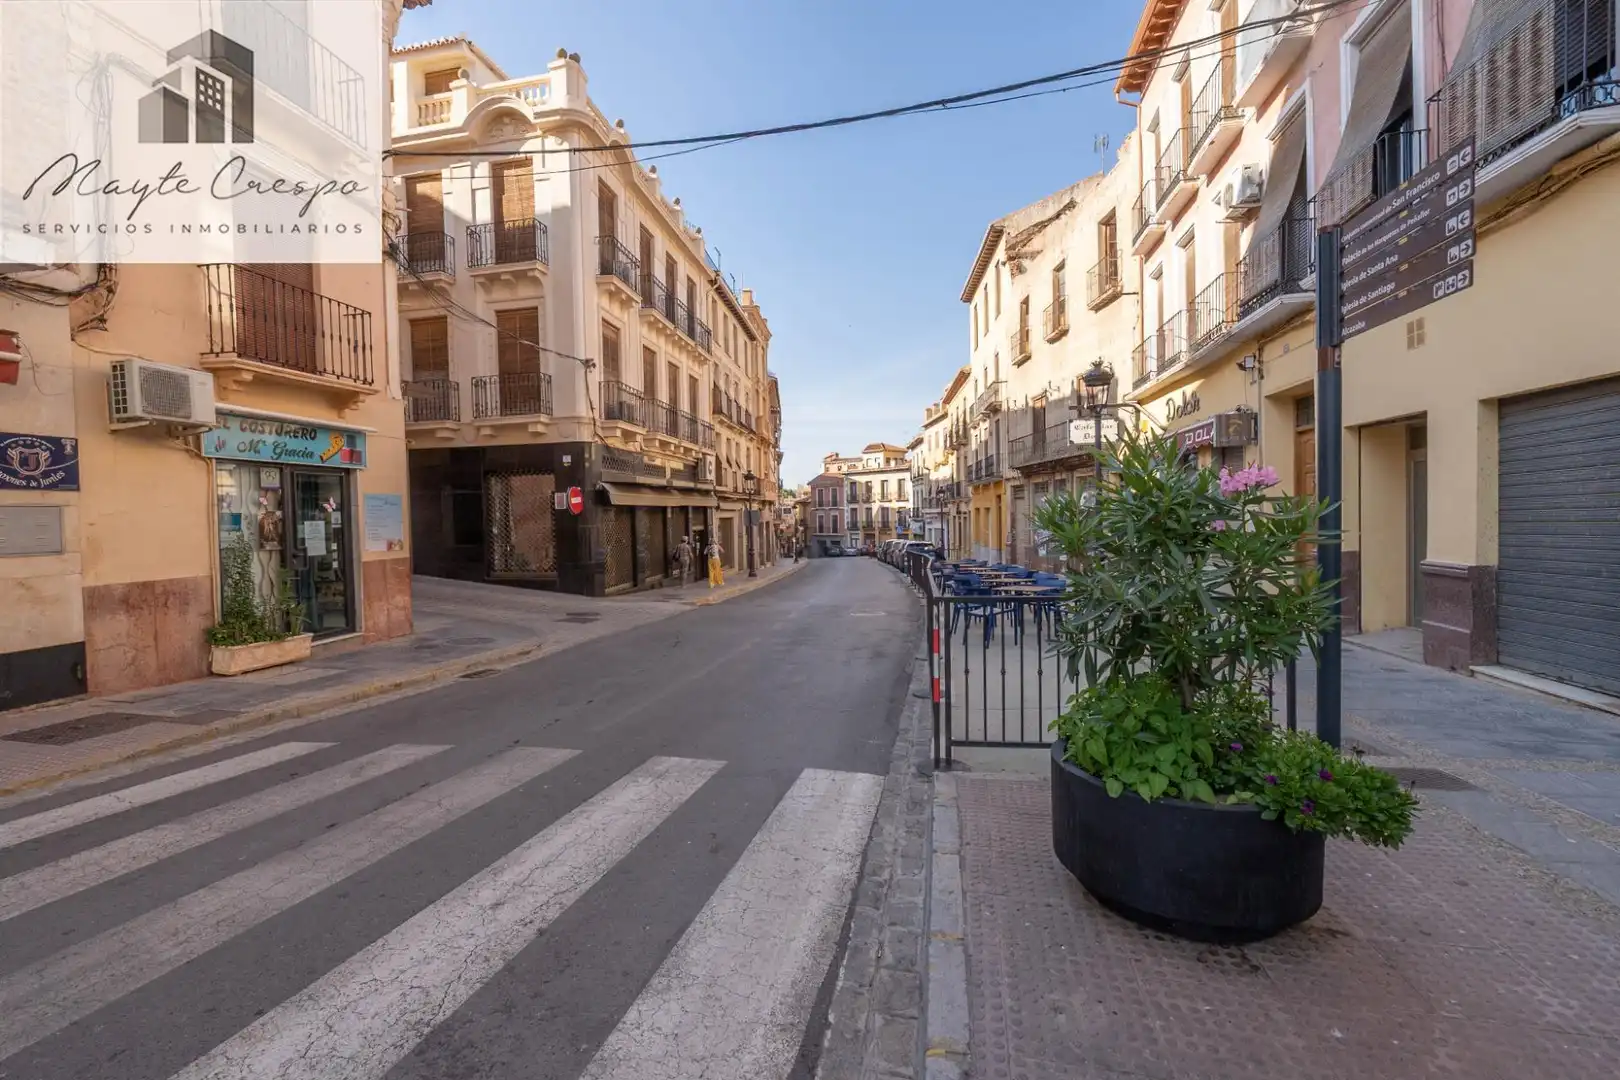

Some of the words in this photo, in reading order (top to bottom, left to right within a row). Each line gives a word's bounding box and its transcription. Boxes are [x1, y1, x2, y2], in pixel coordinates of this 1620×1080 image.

[1392, 196, 1405, 209] San
[1405, 172, 1440, 200] Francisco
[1341, 249, 1361, 267] Palacio
[1400, 223, 1406, 231] de
[1341, 275, 1358, 292] Iglesia
[1359, 271, 1367, 281] de
[1367, 261, 1385, 277] Santa
[1385, 254, 1398, 267] Ana
[1341, 299, 1358, 315] Iglesia
[1360, 295, 1367, 304] de
[1367, 282, 1396, 301] Santiago
[1341, 320, 1366, 336] Alcazaba
[239, 418, 317, 442] COSTURERO
[270, 440, 316, 461] Gracia
[40, 470, 66, 488] Juviles
